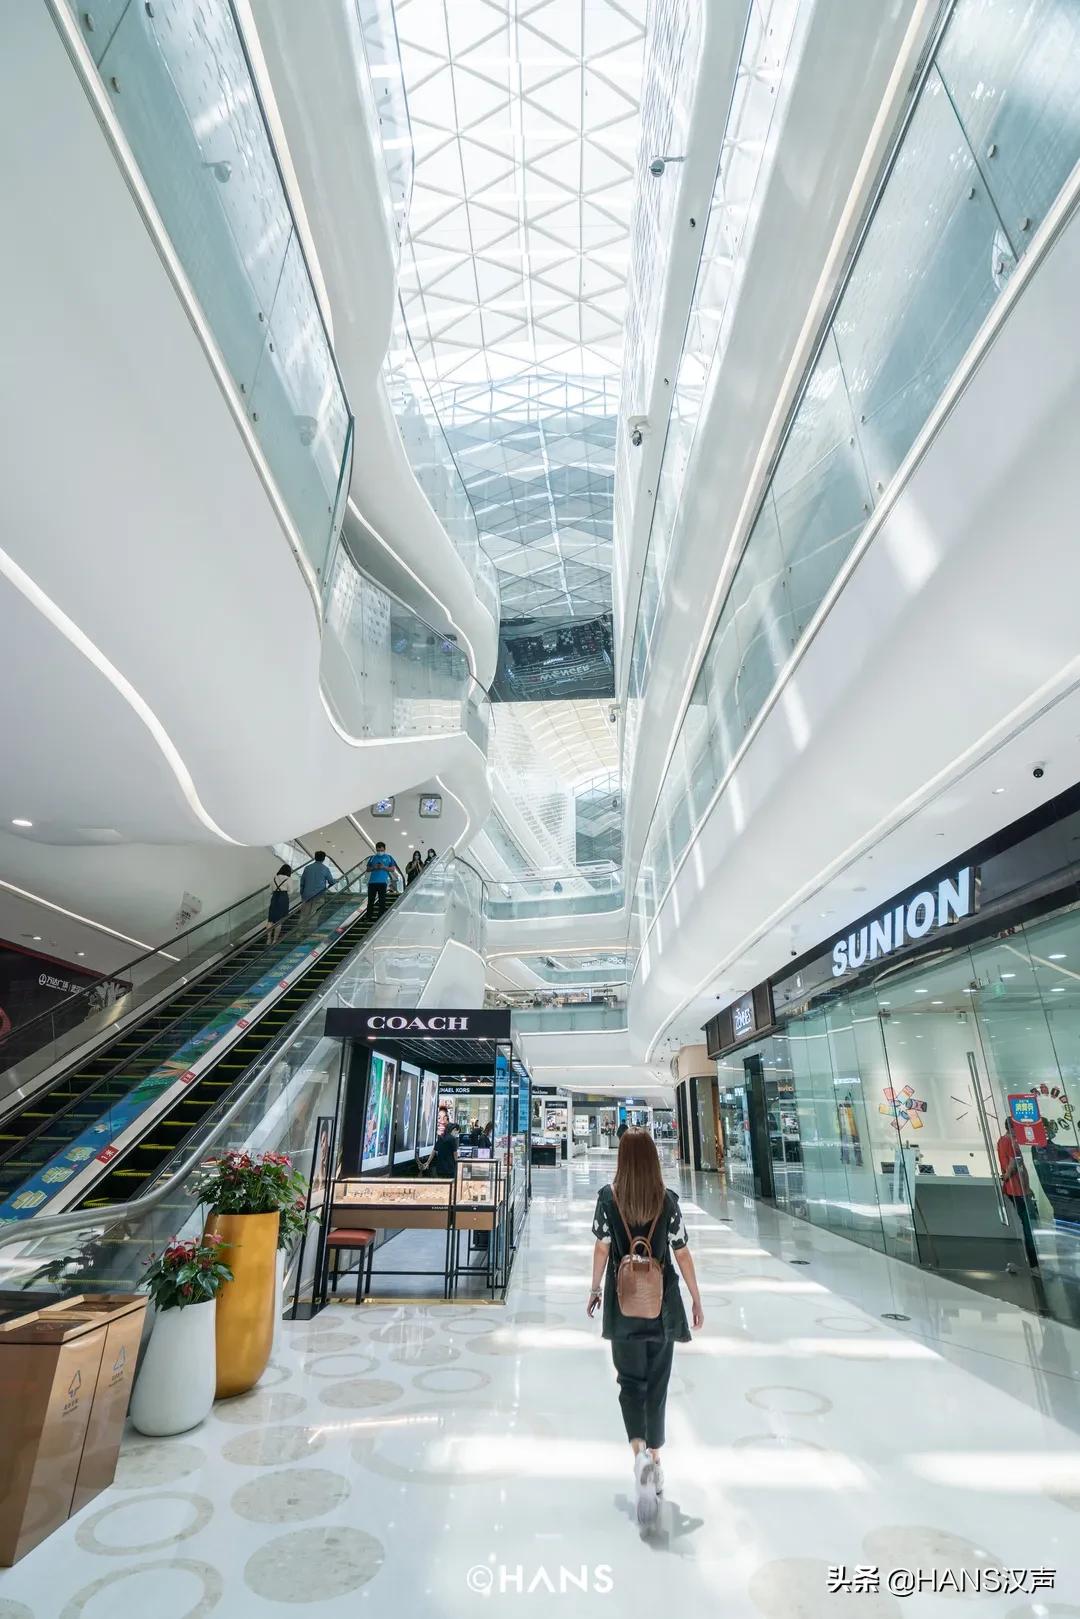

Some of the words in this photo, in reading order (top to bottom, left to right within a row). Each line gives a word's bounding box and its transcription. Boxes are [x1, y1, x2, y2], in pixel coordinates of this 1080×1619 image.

[832, 866, 971, 977] SUNION
[366, 1016, 469, 1030] COACH
[101, 1149, 115, 1160] 1米
